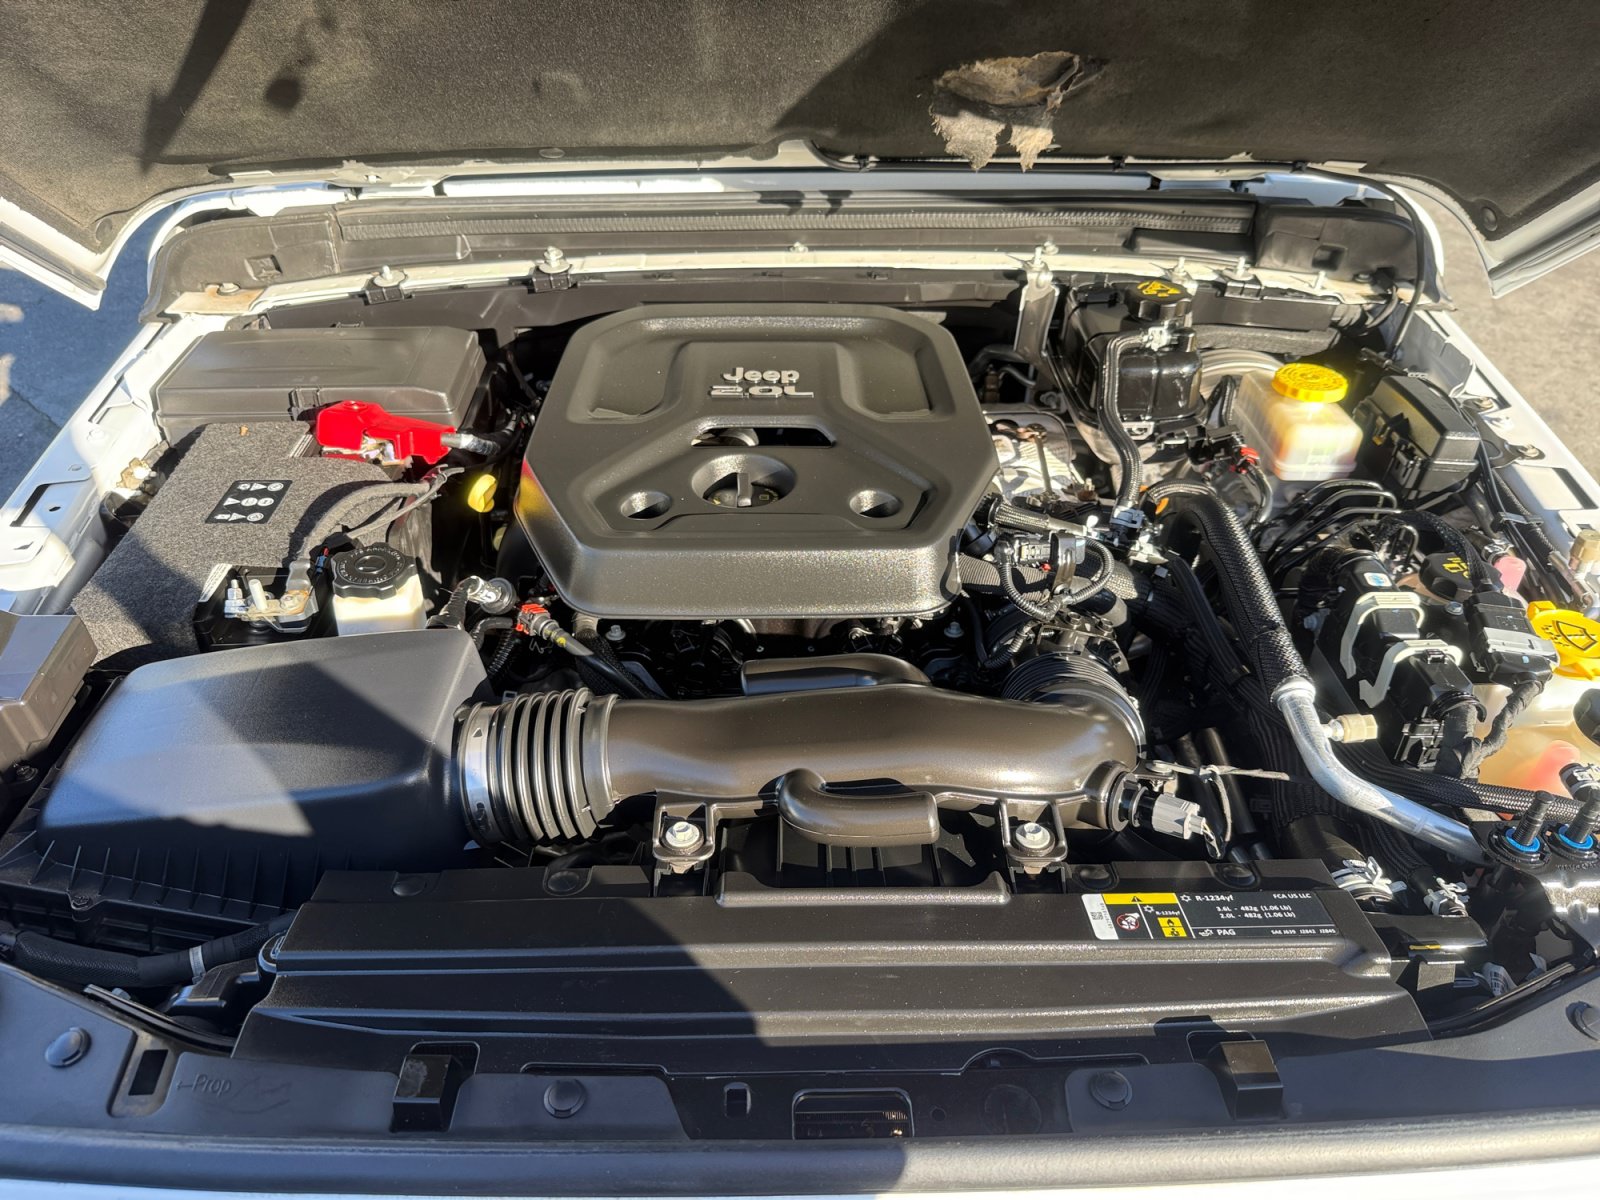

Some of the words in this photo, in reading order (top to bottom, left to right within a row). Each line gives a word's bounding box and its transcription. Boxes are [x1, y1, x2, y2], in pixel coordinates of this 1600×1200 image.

[722, 366, 800, 384] Jeep
[709, 385, 814, 399] 2.0L
[1195, 894, 1234, 902] R-1234yf
[192, 1074, 232, 1097] Prop
